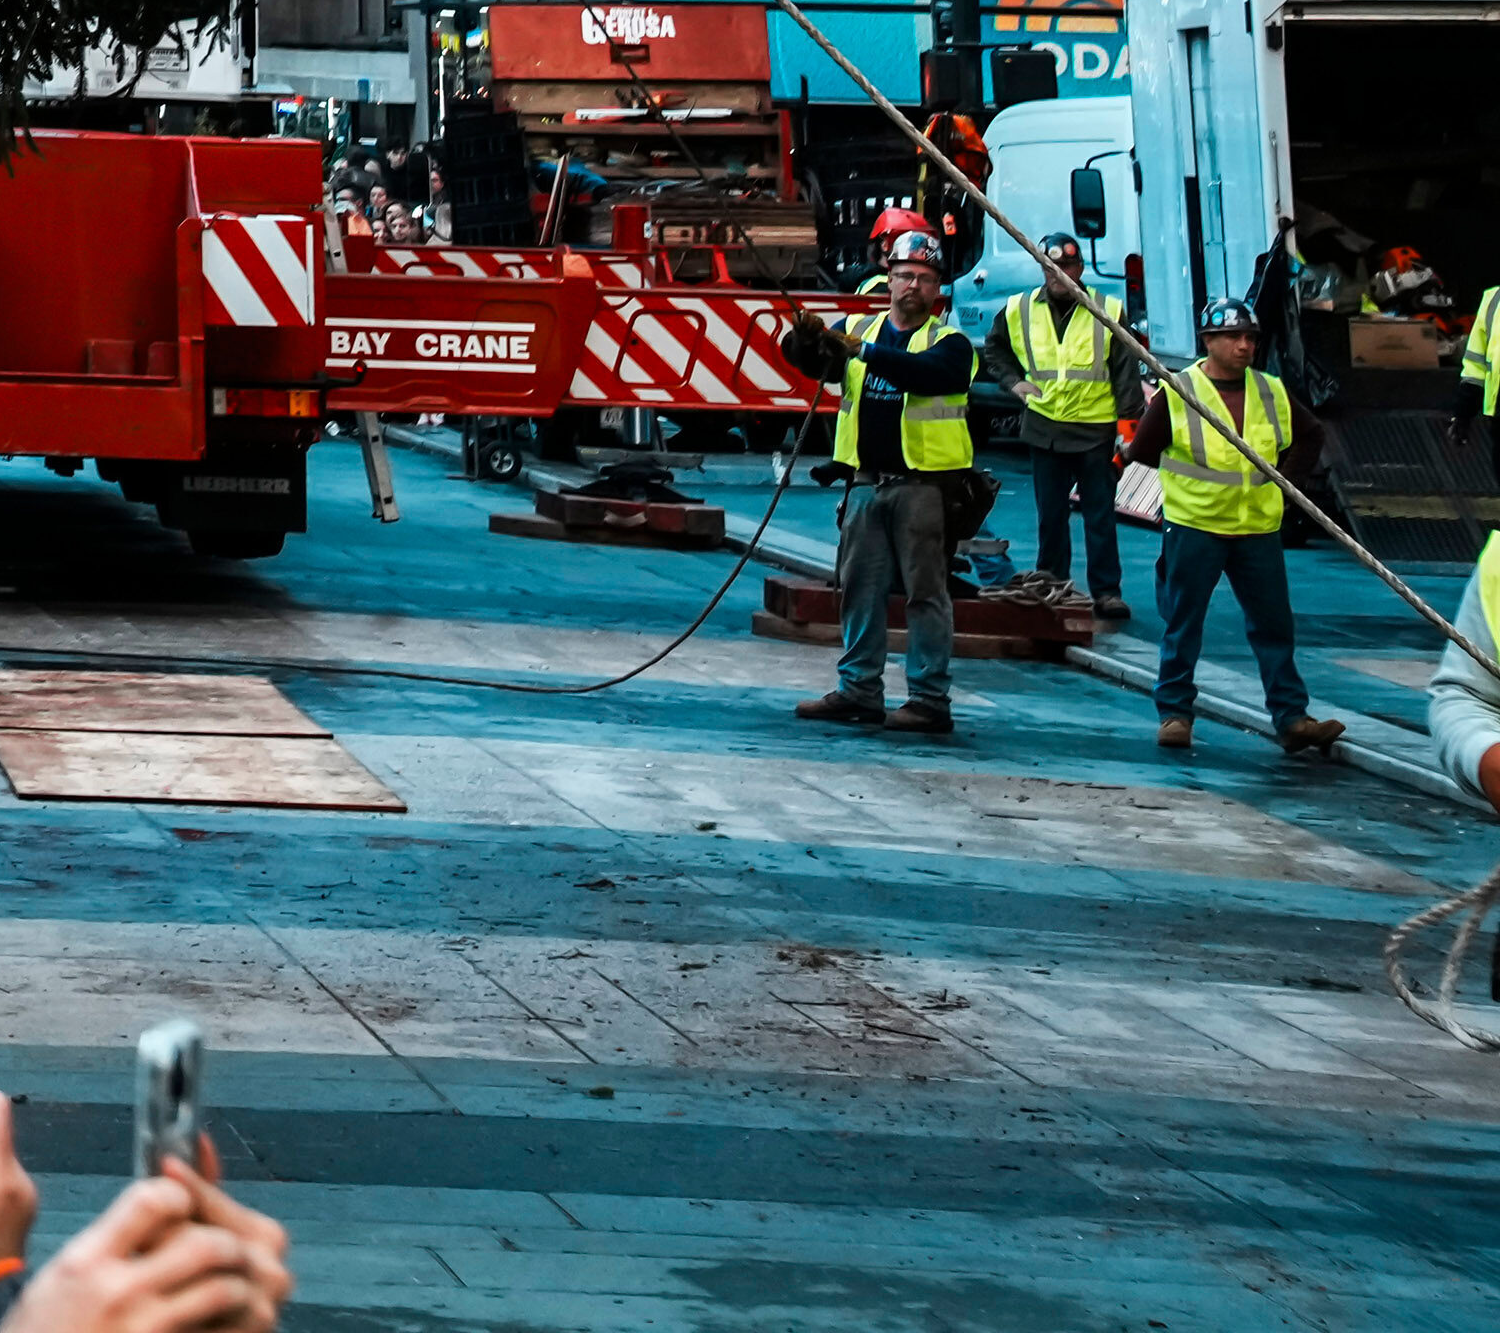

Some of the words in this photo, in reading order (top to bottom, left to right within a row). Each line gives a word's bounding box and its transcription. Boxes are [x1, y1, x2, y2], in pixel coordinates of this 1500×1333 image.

[581, 7, 676, 45] GEROSA
[330, 330, 391, 355] BAY
[415, 332, 530, 360] CRANE
